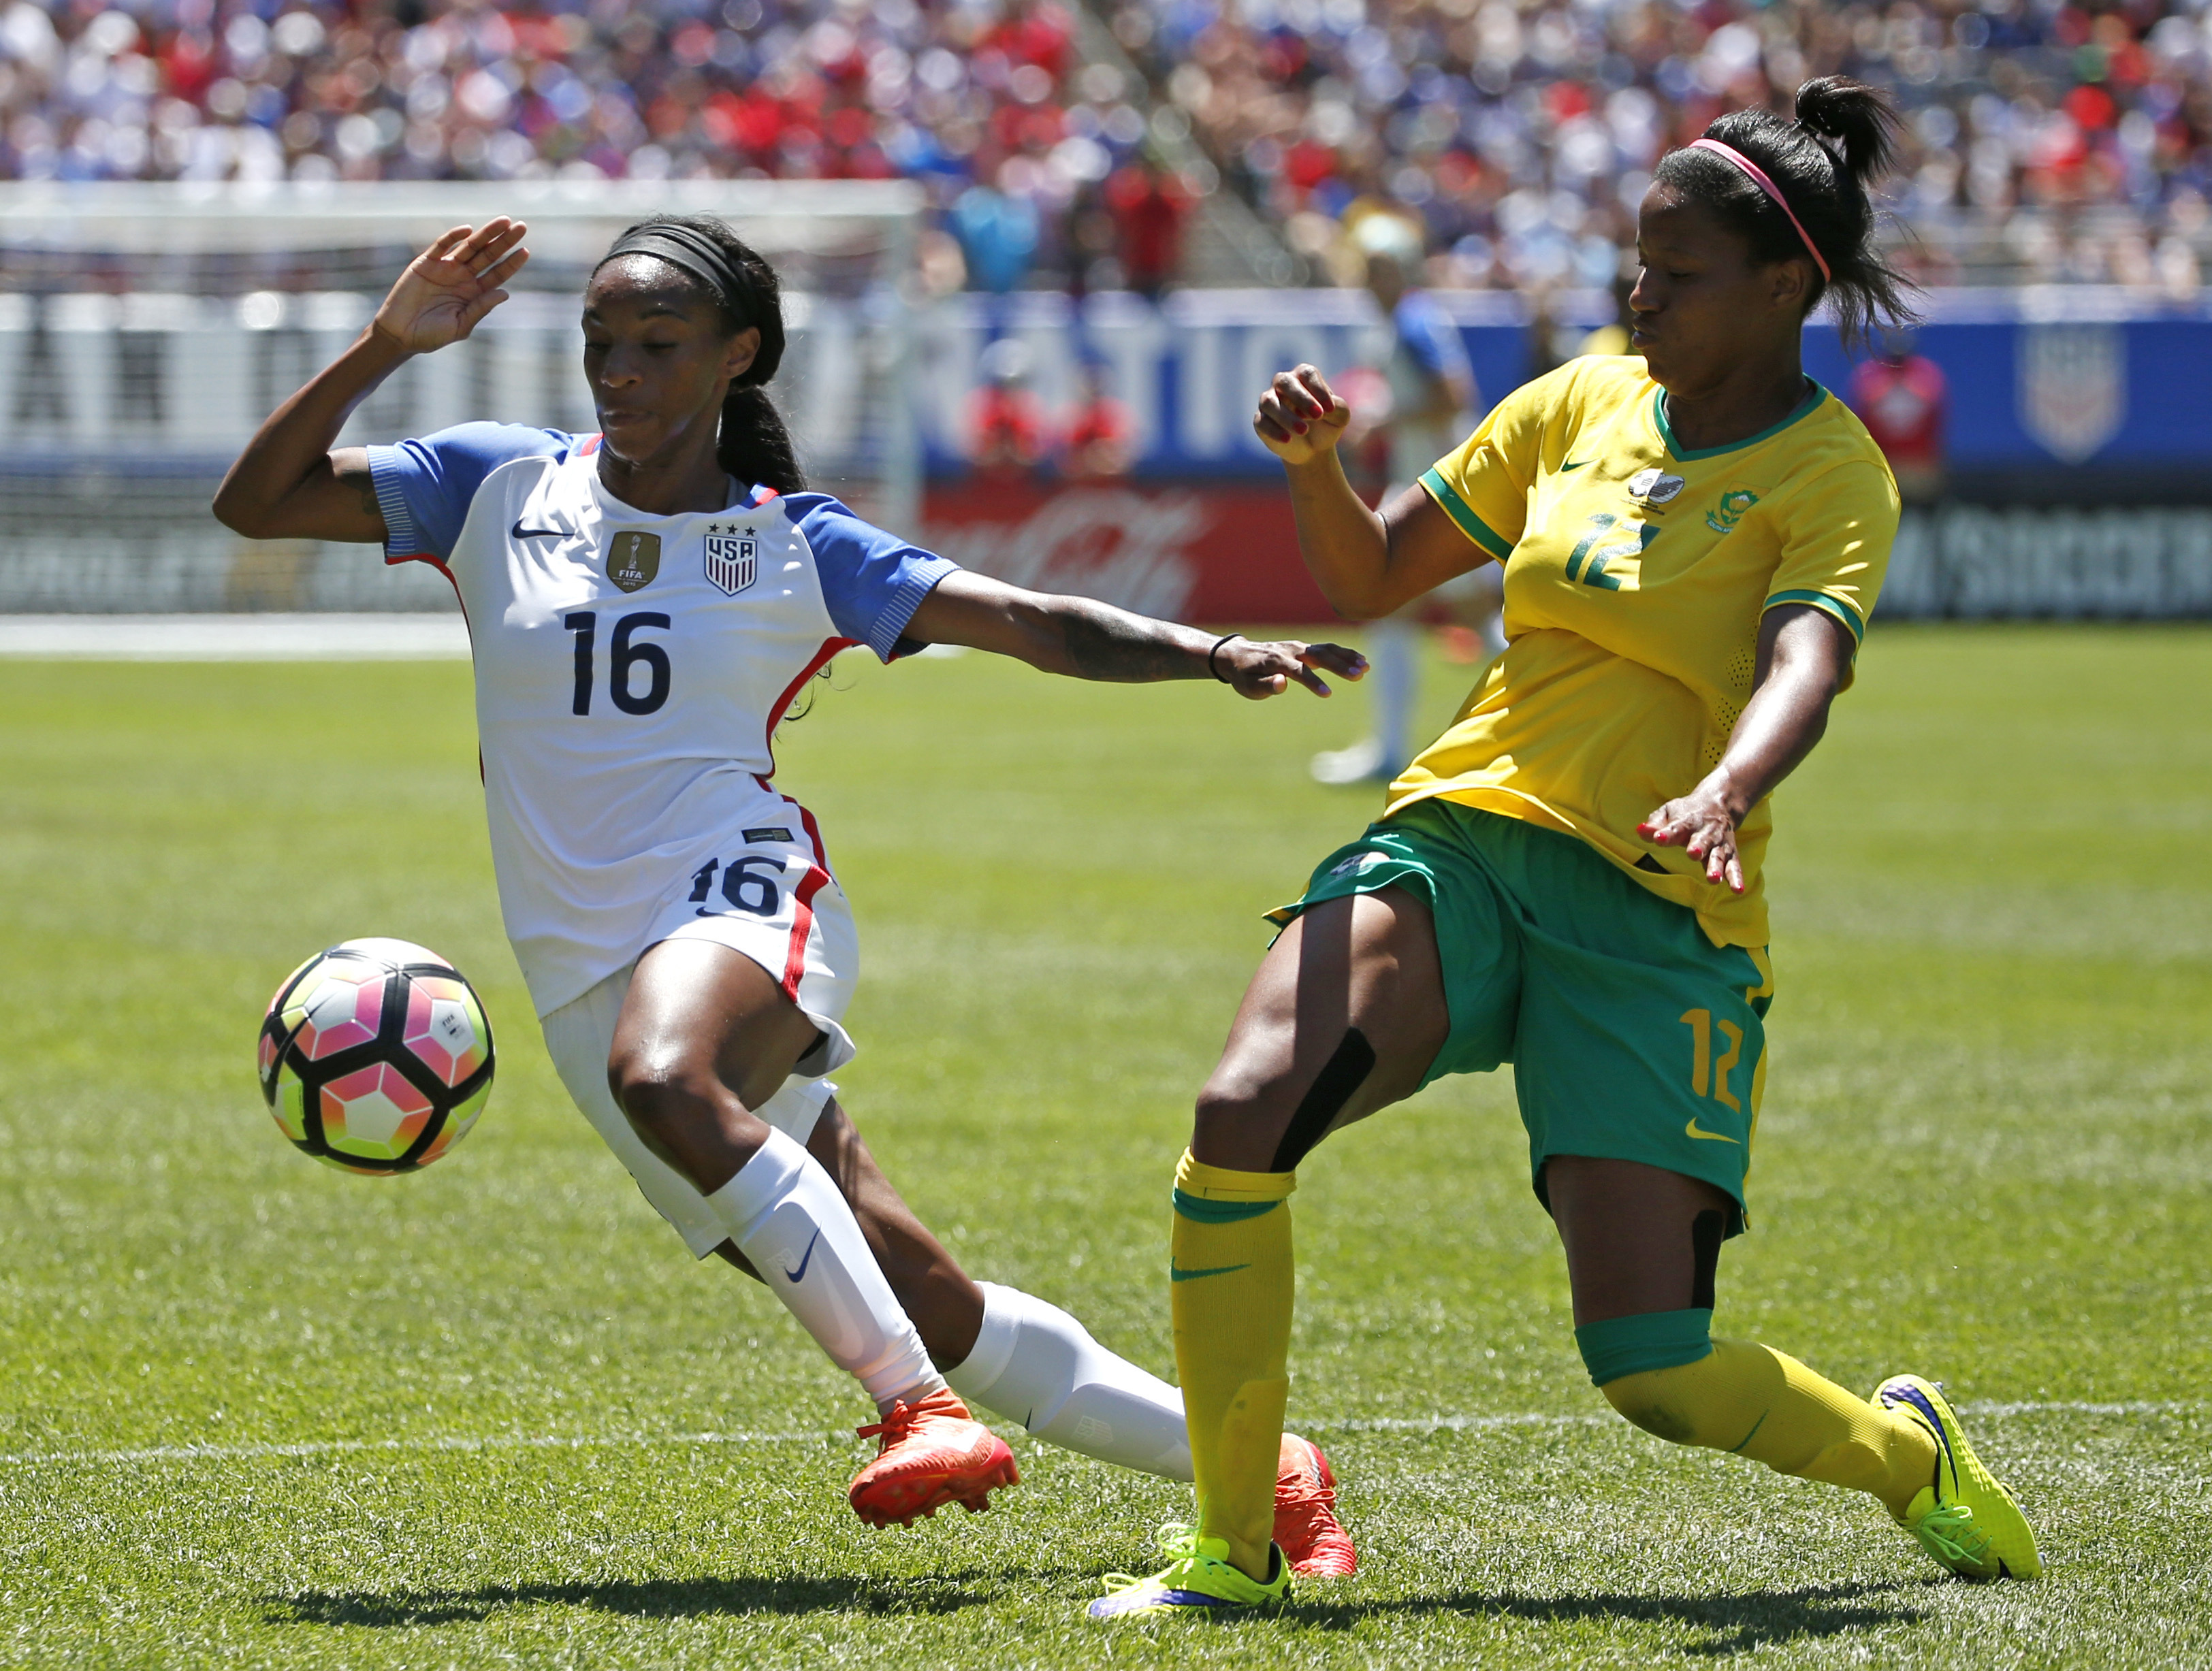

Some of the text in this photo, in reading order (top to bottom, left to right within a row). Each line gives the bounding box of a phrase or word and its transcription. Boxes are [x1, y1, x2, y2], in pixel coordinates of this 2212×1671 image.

[619, 569, 642, 579] FIFA
[709, 538, 752, 561] USA
[1566, 513, 1661, 591] 12
[564, 611, 671, 716] 16
[688, 856, 786, 917] 16
[1679, 1008, 1744, 1114] 12
